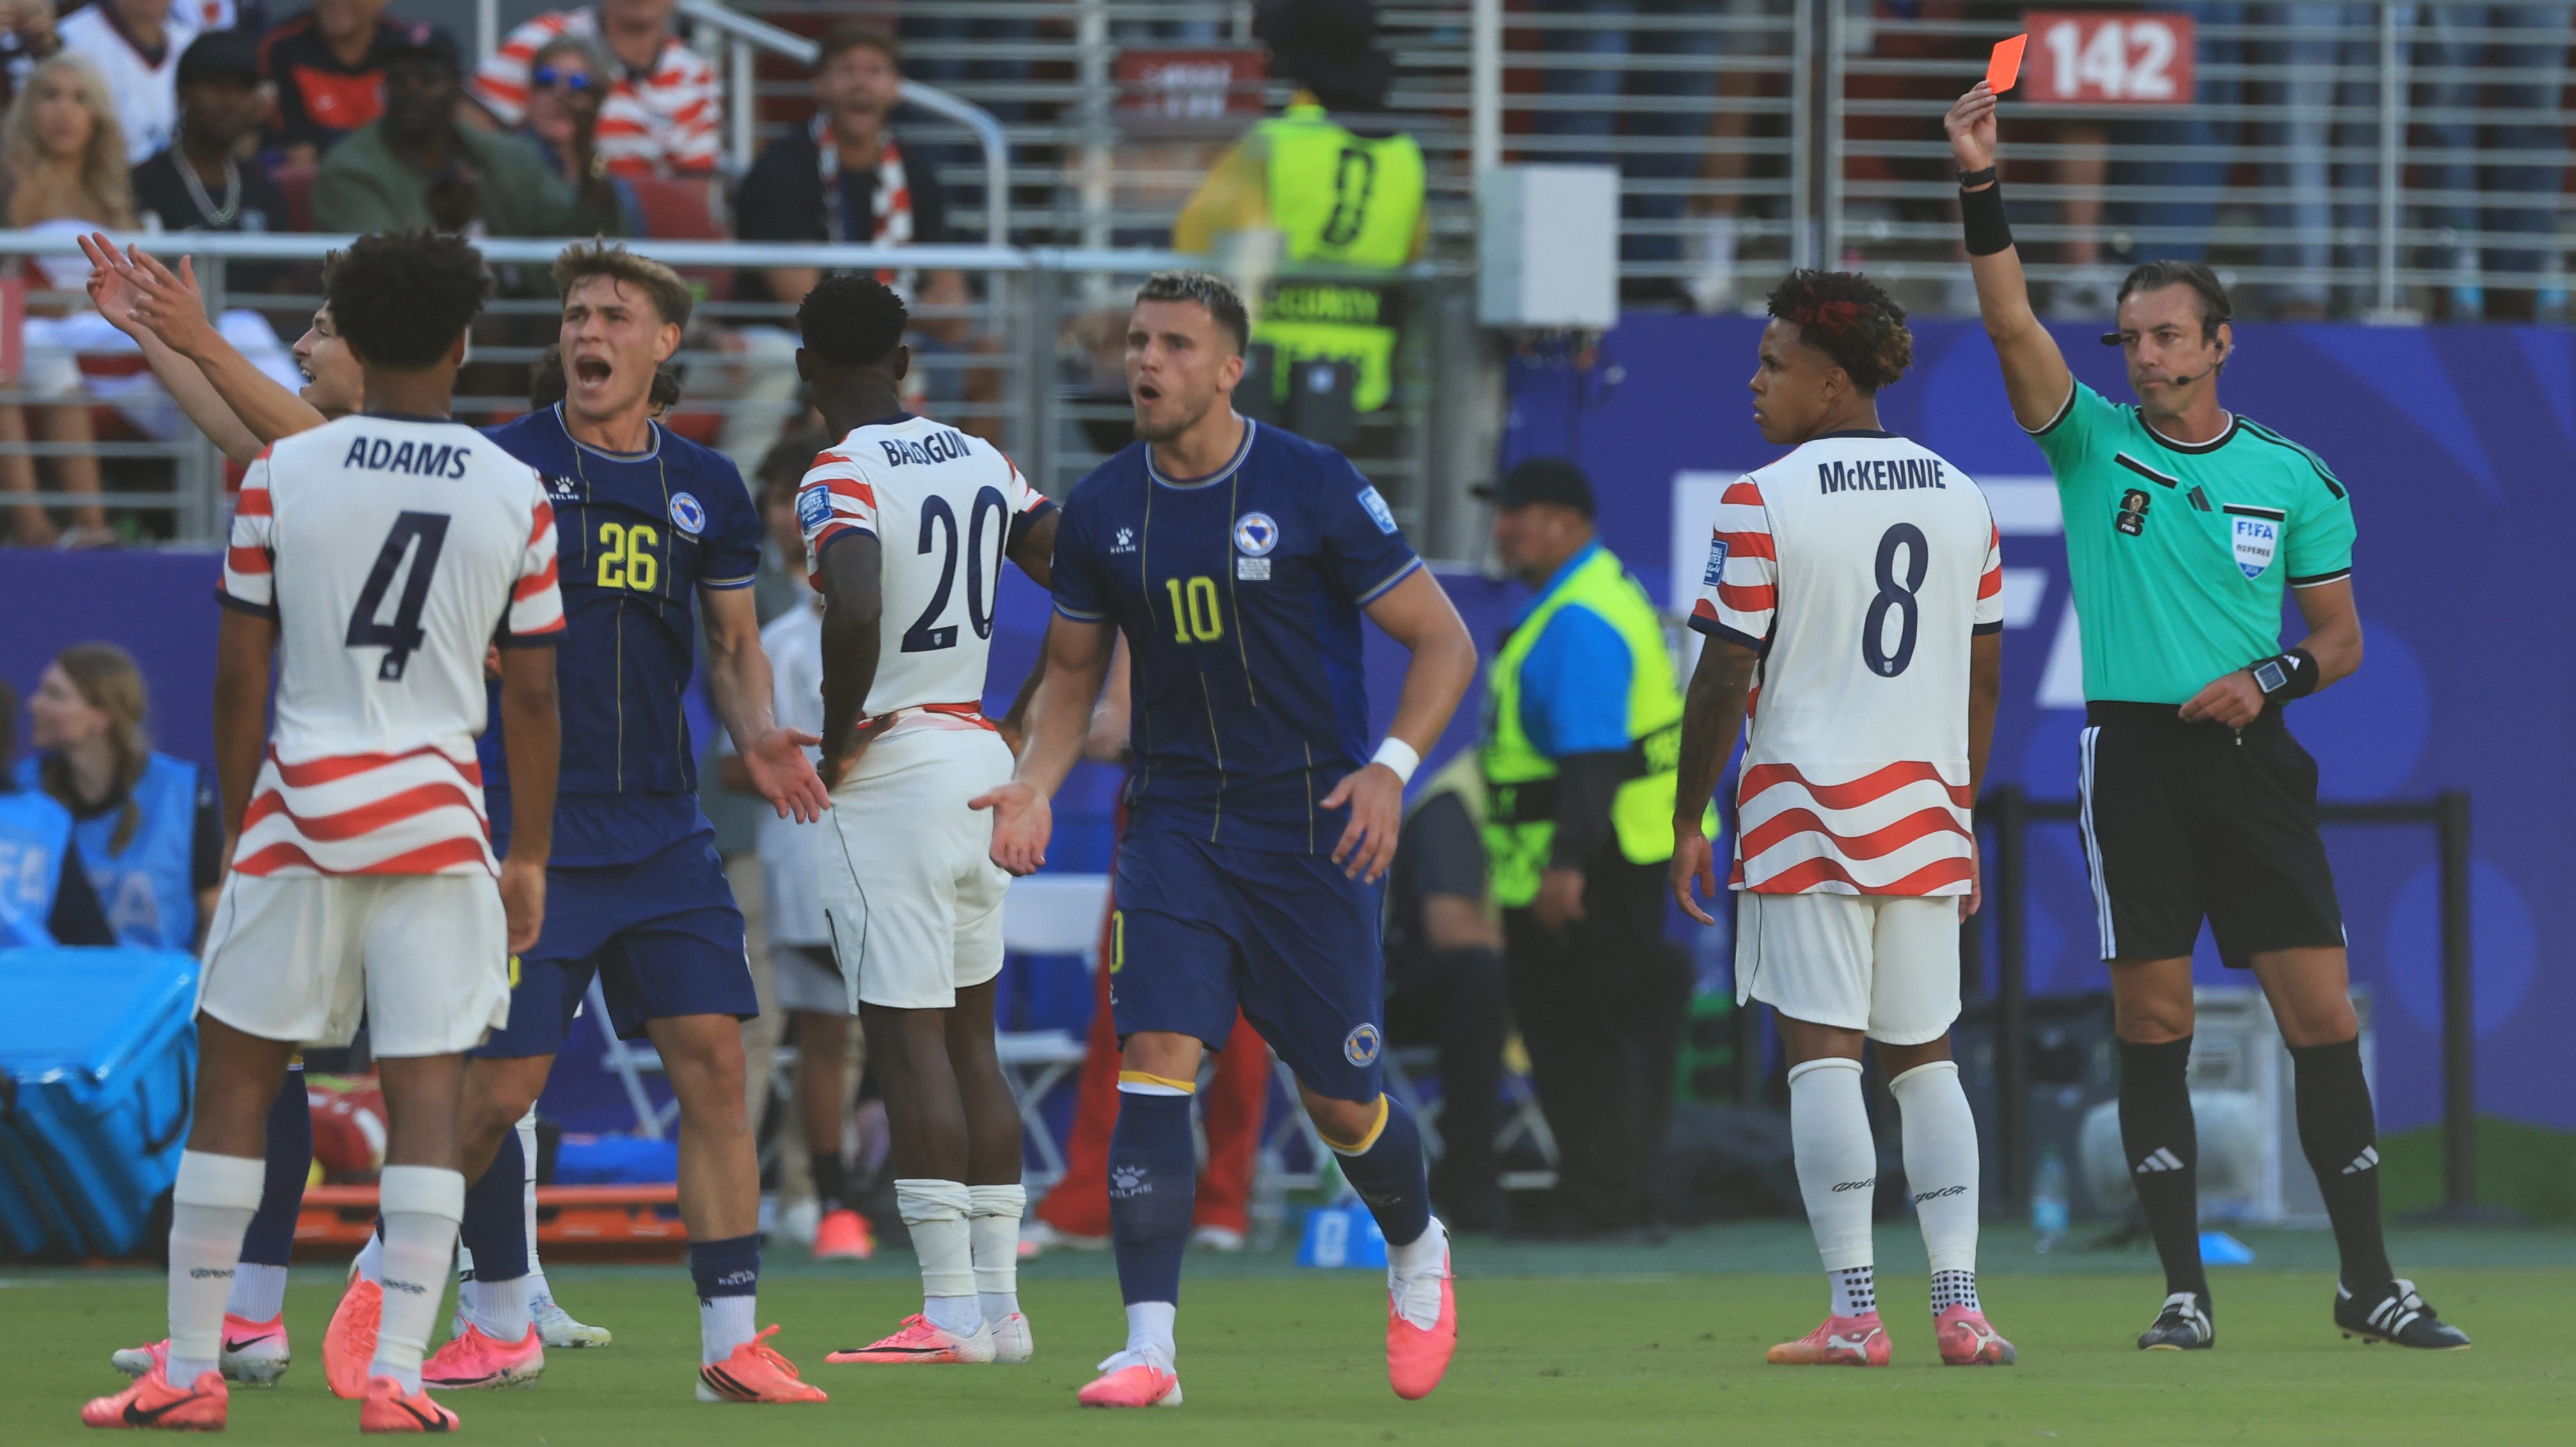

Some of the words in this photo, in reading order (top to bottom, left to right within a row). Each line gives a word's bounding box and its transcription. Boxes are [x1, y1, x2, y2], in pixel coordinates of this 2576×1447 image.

[2046, 20, 2176, 99] 142
[344, 437, 471, 479] ADAMS
[879, 428, 971, 468] BALOGUN
[1818, 459, 1946, 494] McKENNIE
[597, 522, 658, 592] 26
[2236, 544, 2271, 557] REFEREE
[2237, 521, 2274, 539] FIFA
[345, 510, 451, 681] 4
[900, 486, 1008, 653] 20
[1862, 523, 1929, 678] 8
[1165, 576, 1224, 644] 10
